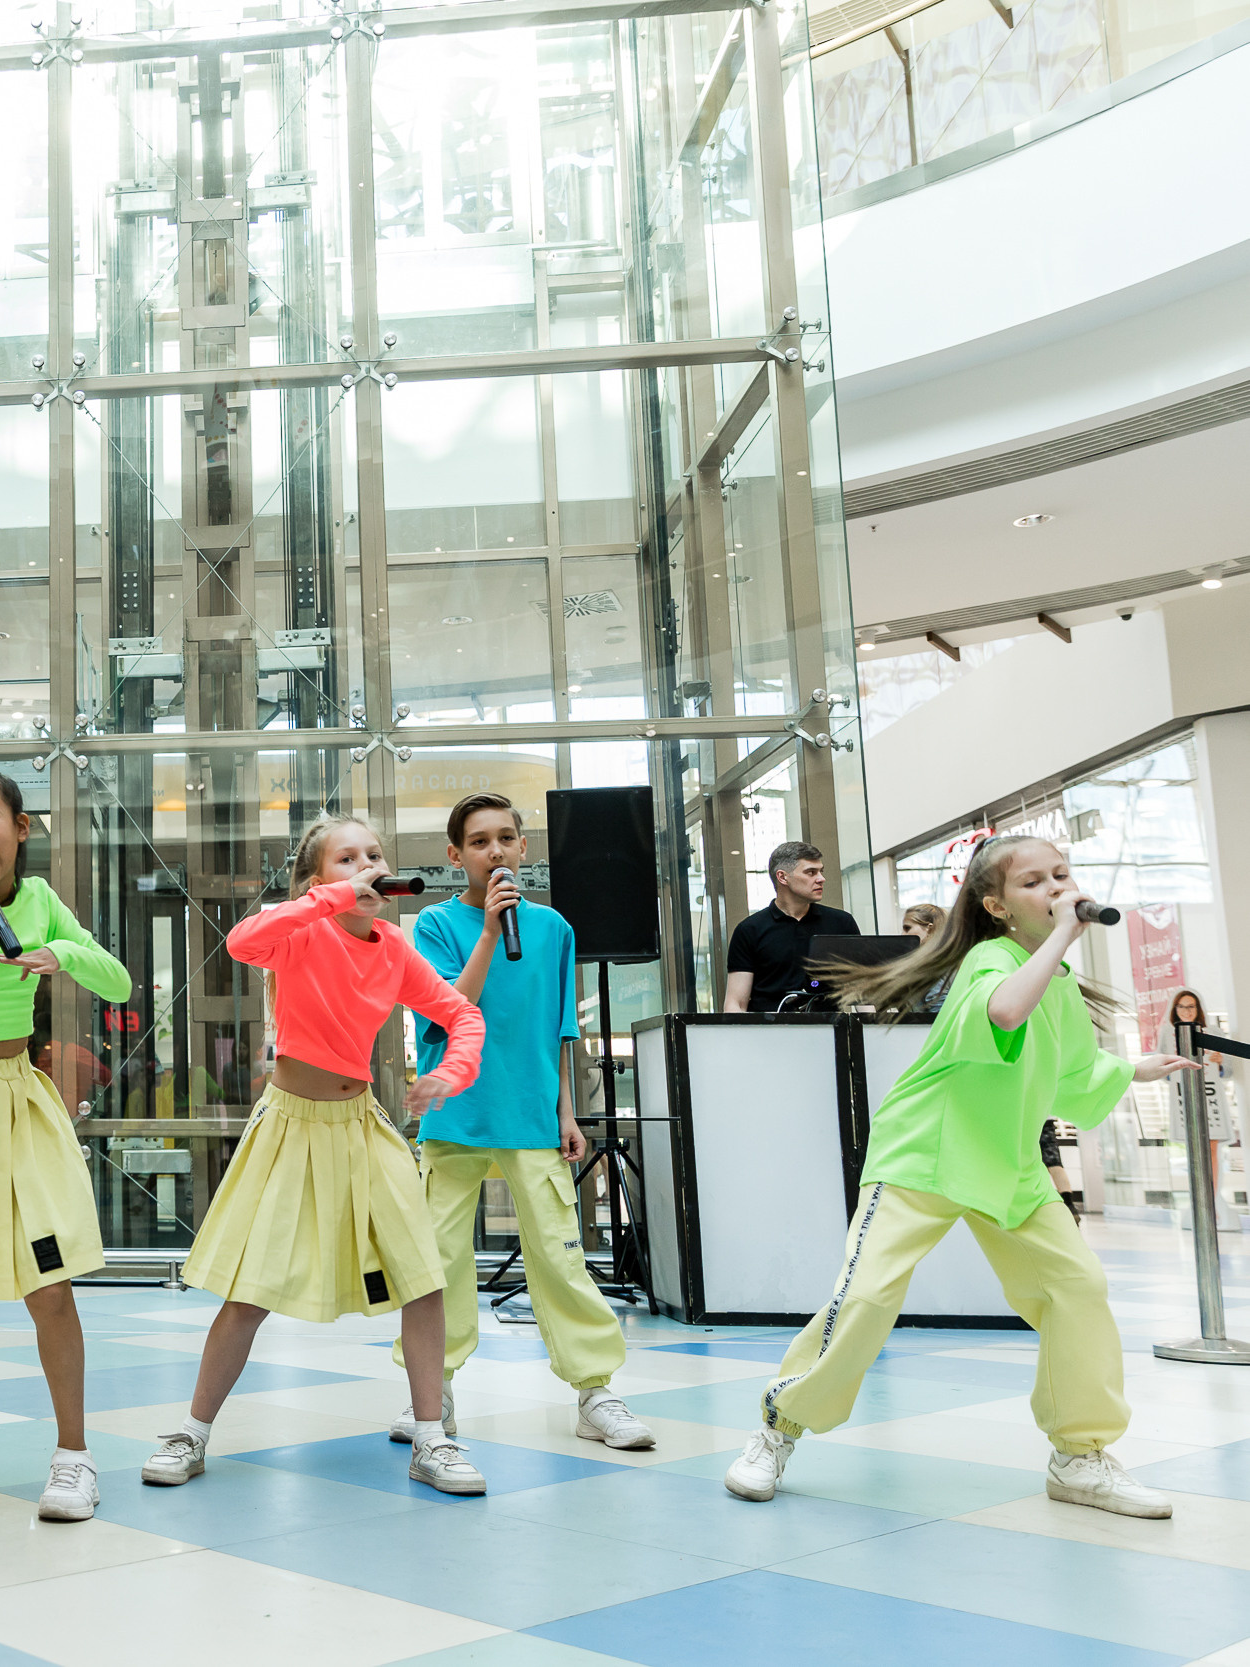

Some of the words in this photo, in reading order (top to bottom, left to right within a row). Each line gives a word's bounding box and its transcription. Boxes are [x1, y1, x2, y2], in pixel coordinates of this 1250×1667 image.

[362, 774, 491, 790] RACARD
[861, 1209, 874, 1230] TIME
[564, 1240, 578, 1249] TIME
[823, 1307, 837, 1337] WANG
